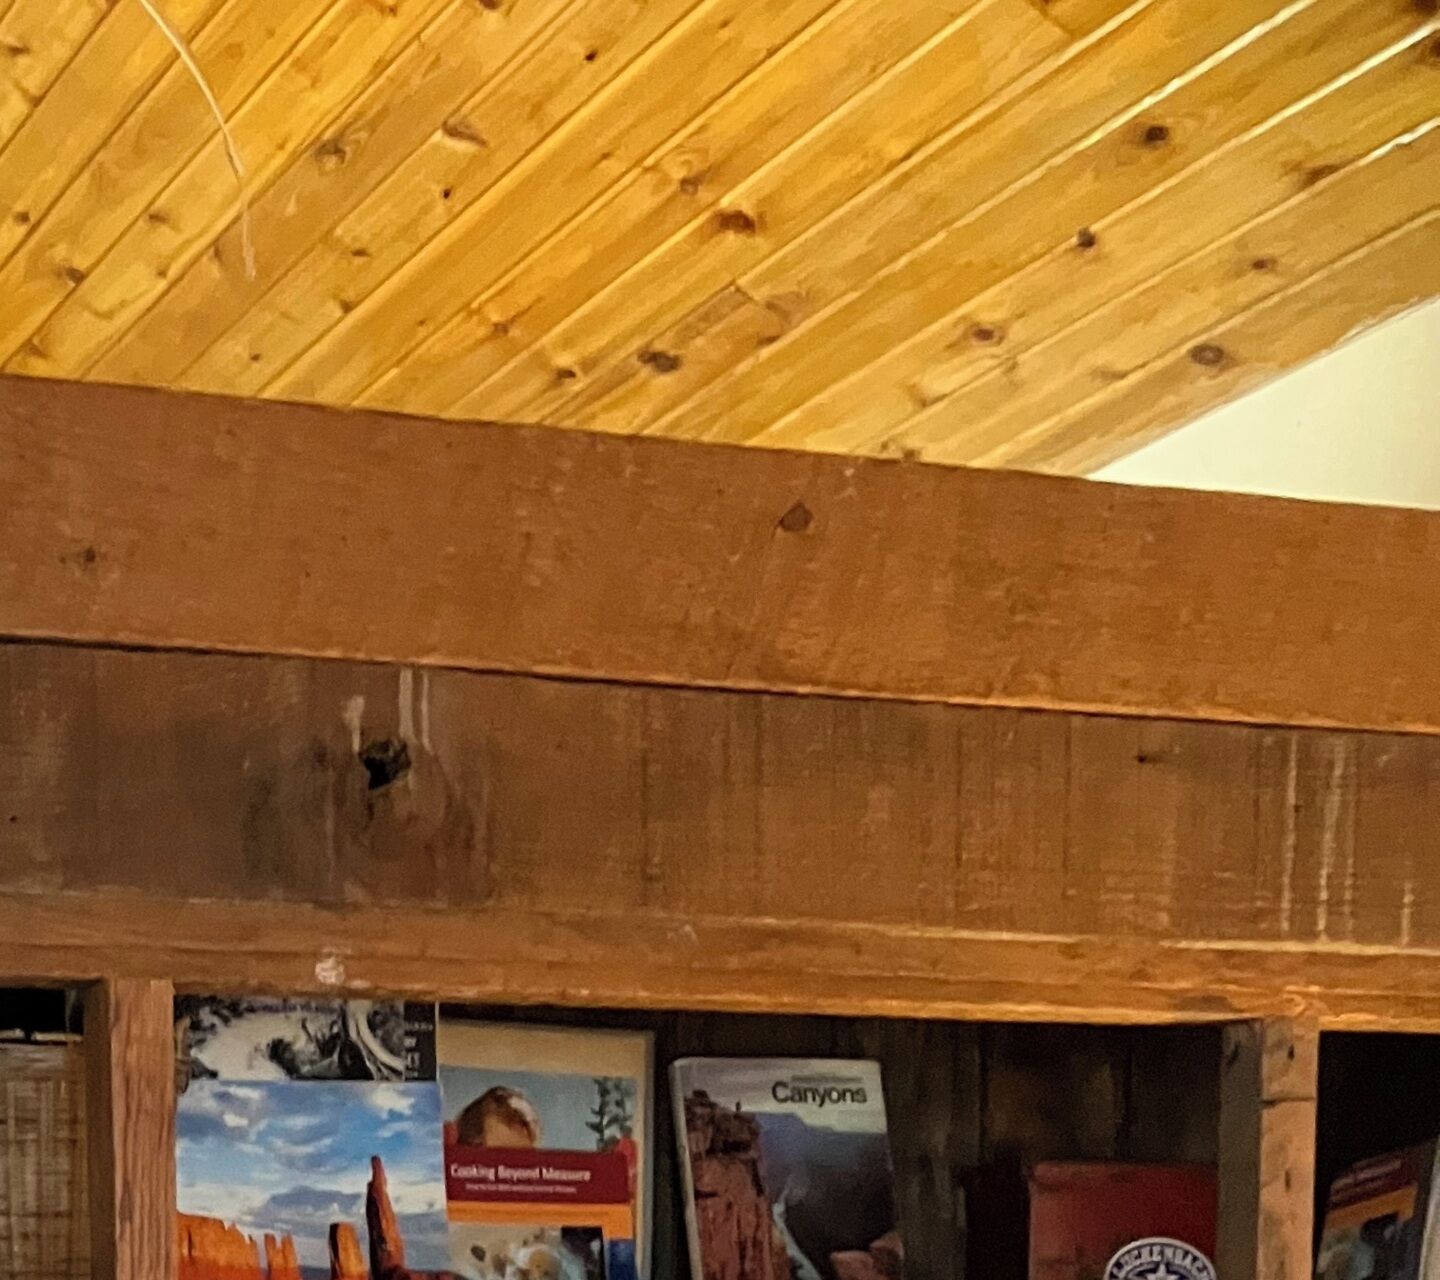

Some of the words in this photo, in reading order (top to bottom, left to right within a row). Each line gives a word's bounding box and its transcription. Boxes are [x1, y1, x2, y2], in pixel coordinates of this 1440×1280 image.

[771, 1080, 868, 1108] Canyons
[450, 1163, 496, 1182] Cooking
[497, 1165, 540, 1182] Beyond
[541, 1167, 592, 1182] Measure
